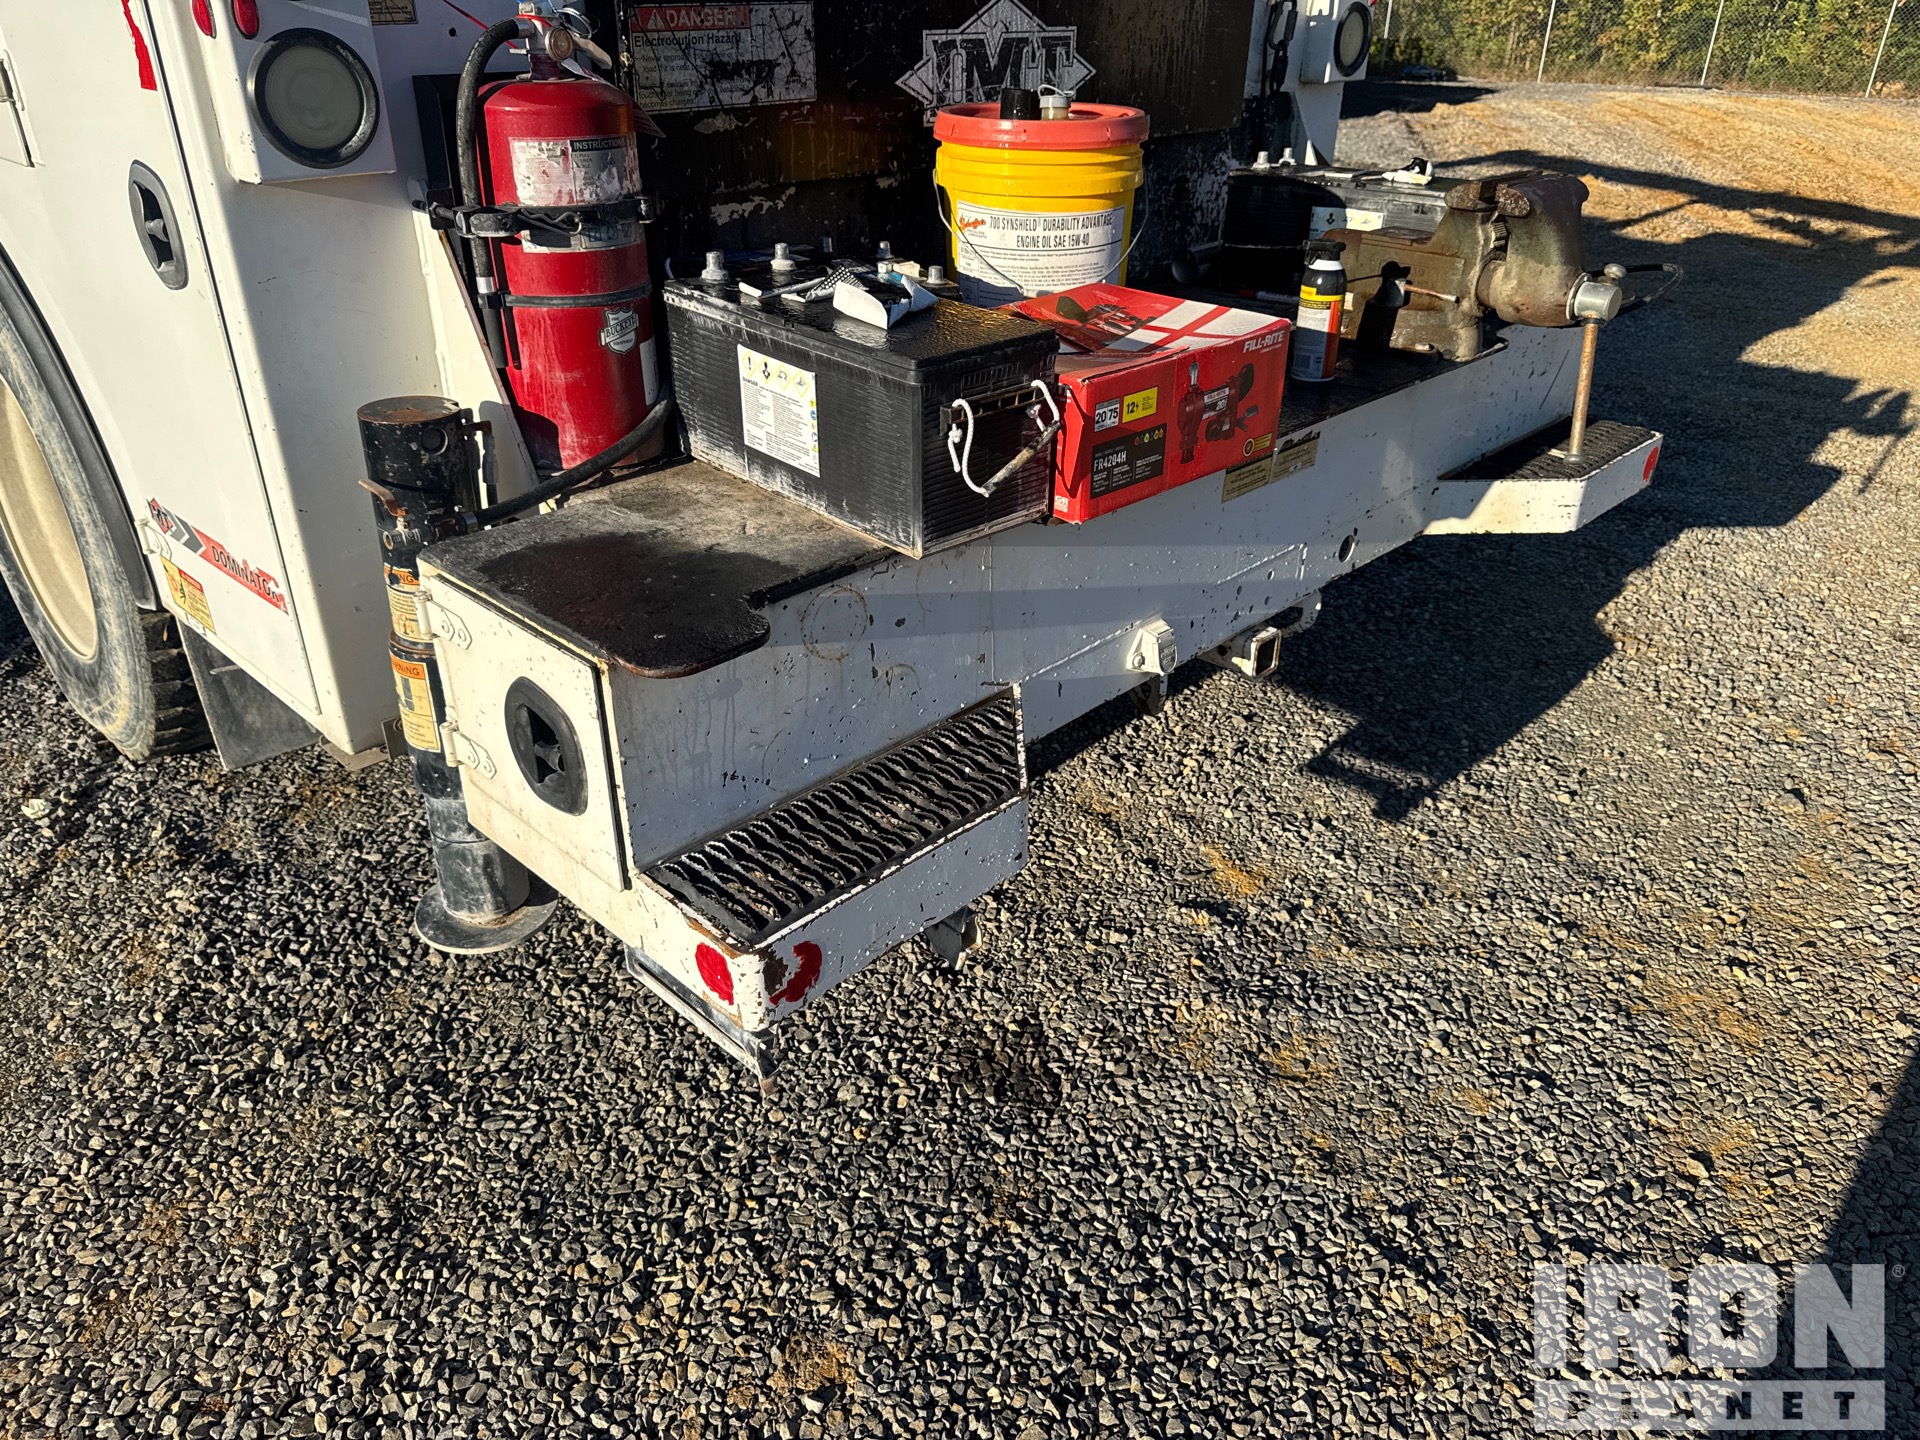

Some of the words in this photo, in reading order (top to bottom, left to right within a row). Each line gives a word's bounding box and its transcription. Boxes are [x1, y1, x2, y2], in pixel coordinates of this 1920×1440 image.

[665, 9, 737, 28] DANGER
[634, 33, 704, 48] Electrocution
[706, 32, 741, 45] Hazard
[642, 55, 662, 63] Nevr
[573, 138, 626, 150] INSTRUCTIONS
[989, 215, 1000, 230] 700
[1042, 216, 1080, 232] DURABILITY
[1081, 212, 1113, 230] ADVANTAGE
[1016, 236, 1040, 249] ENGINE
[1041, 236, 1052, 249] OIL
[1053, 235, 1066, 249] SAE
[1068, 233, 1090, 248] 15W-40
[605, 313, 636, 338] BUCKEYE
[1242, 330, 1285, 354] FILL-RITE
[1095, 410, 1107, 425] 20
[1107, 406, 1119, 421] 75
[1093, 450, 1127, 472] FR4204H
